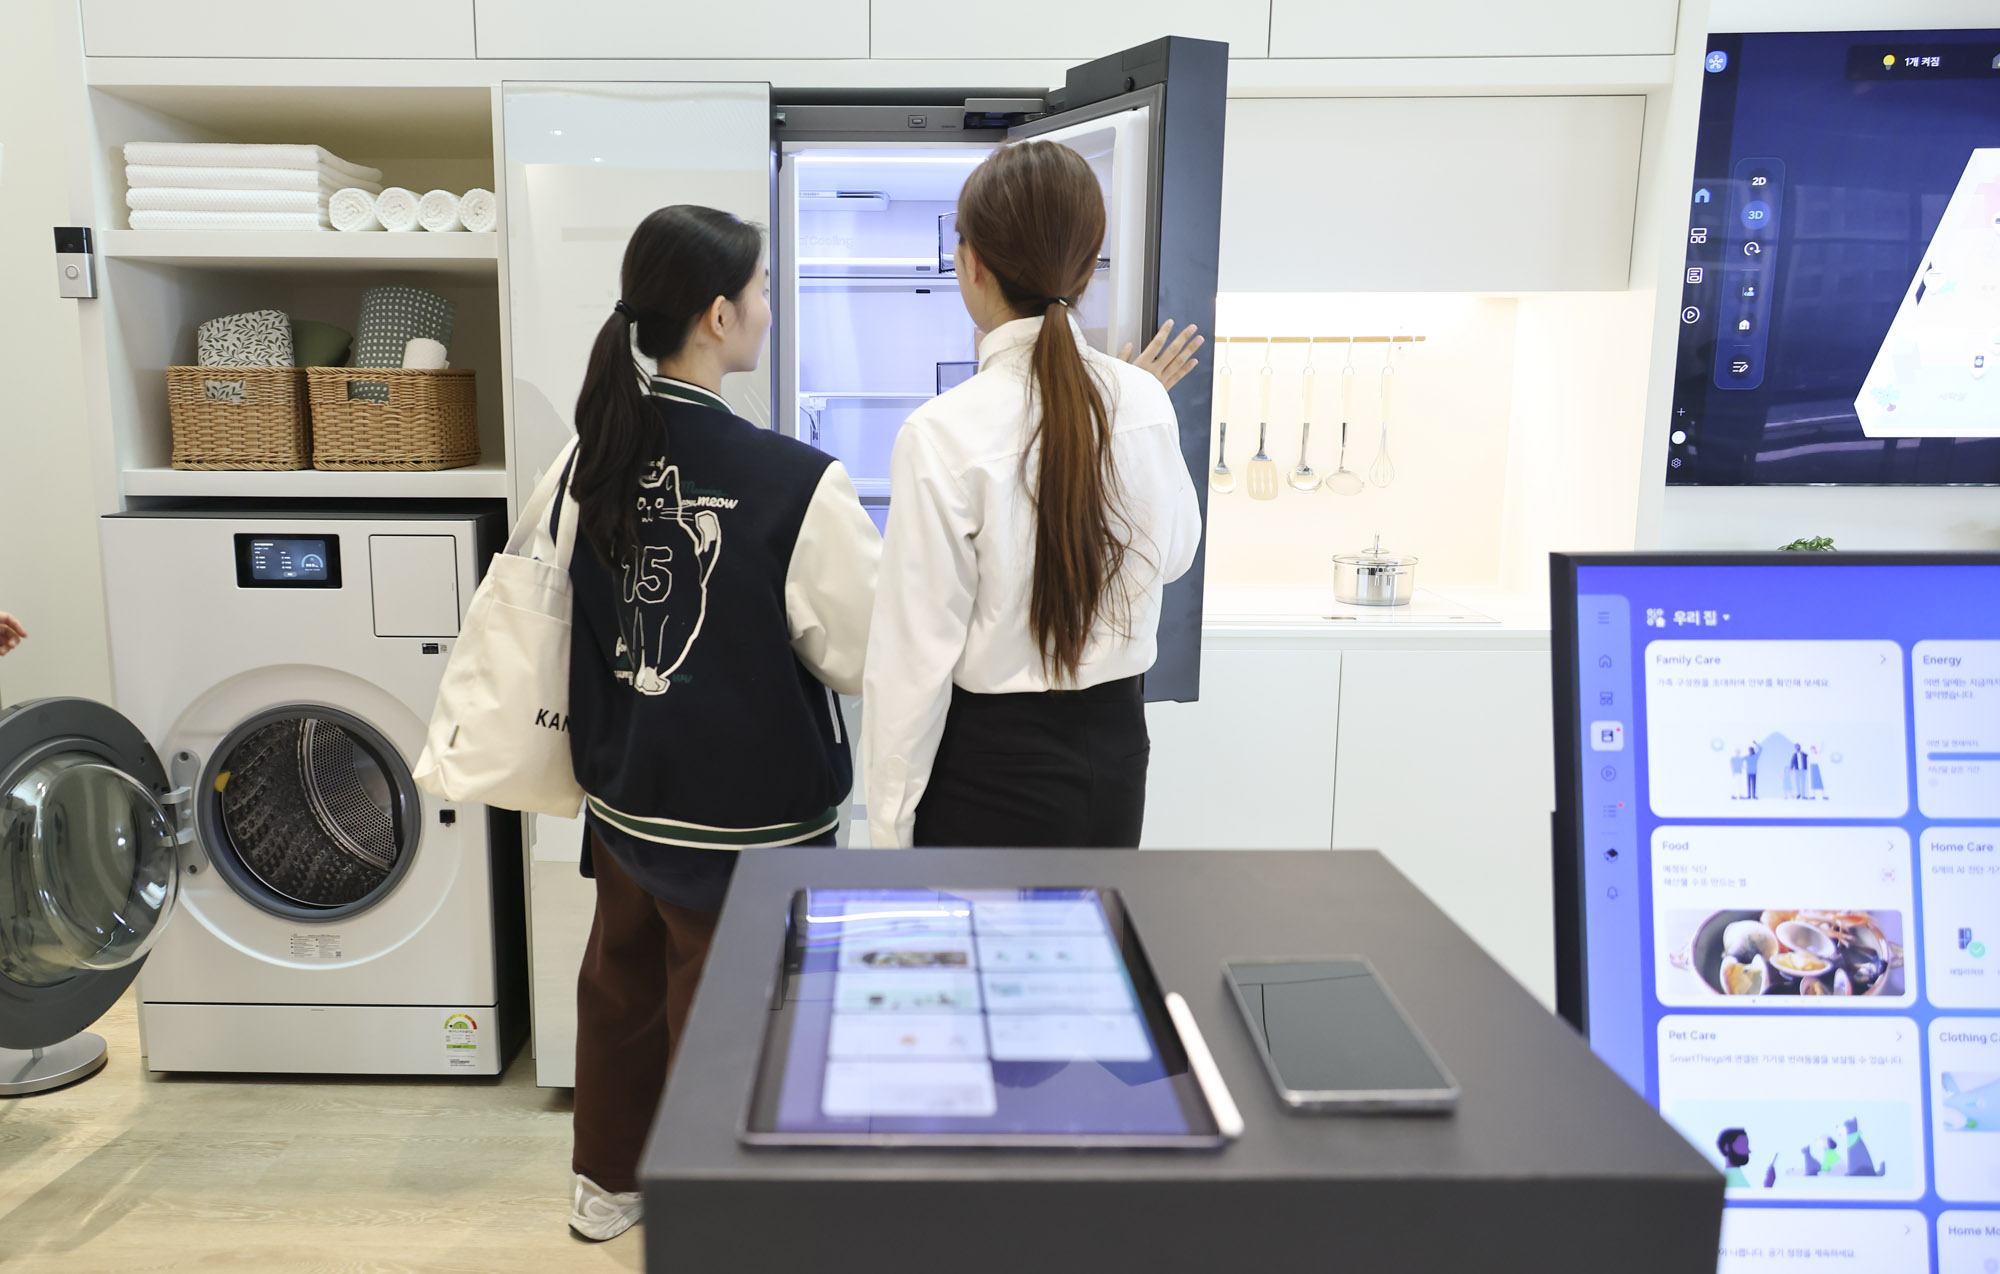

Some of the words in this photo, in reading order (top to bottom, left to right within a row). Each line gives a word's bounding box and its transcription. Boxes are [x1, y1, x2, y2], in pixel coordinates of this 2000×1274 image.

[1904, 56, 1920, 67] 1개
[1921, 56, 1941, 67] 켜짐
[1752, 176, 1767, 186] 2D
[1748, 210, 1764, 220] 3D
[1673, 610, 1700, 626] 우리
[1703, 610, 1717, 626] 집
[1656, 654, 1692, 666] Family
[1695, 654, 1721, 665] Care
[1923, 654, 1962, 667] Energy
[535, 708, 570, 732] KAN
[1662, 840, 1689, 851] Food
[1931, 842, 1964, 852] Home
[1966, 842, 1994, 852] Care
[1668, 1030, 1687, 1040] Pet
[1690, 1030, 1717, 1040] Care
[1939, 1031, 1987, 1044] Clothing
[1990, 1031, 2000, 1043] C
[1948, 1226, 1982, 1236] Home
